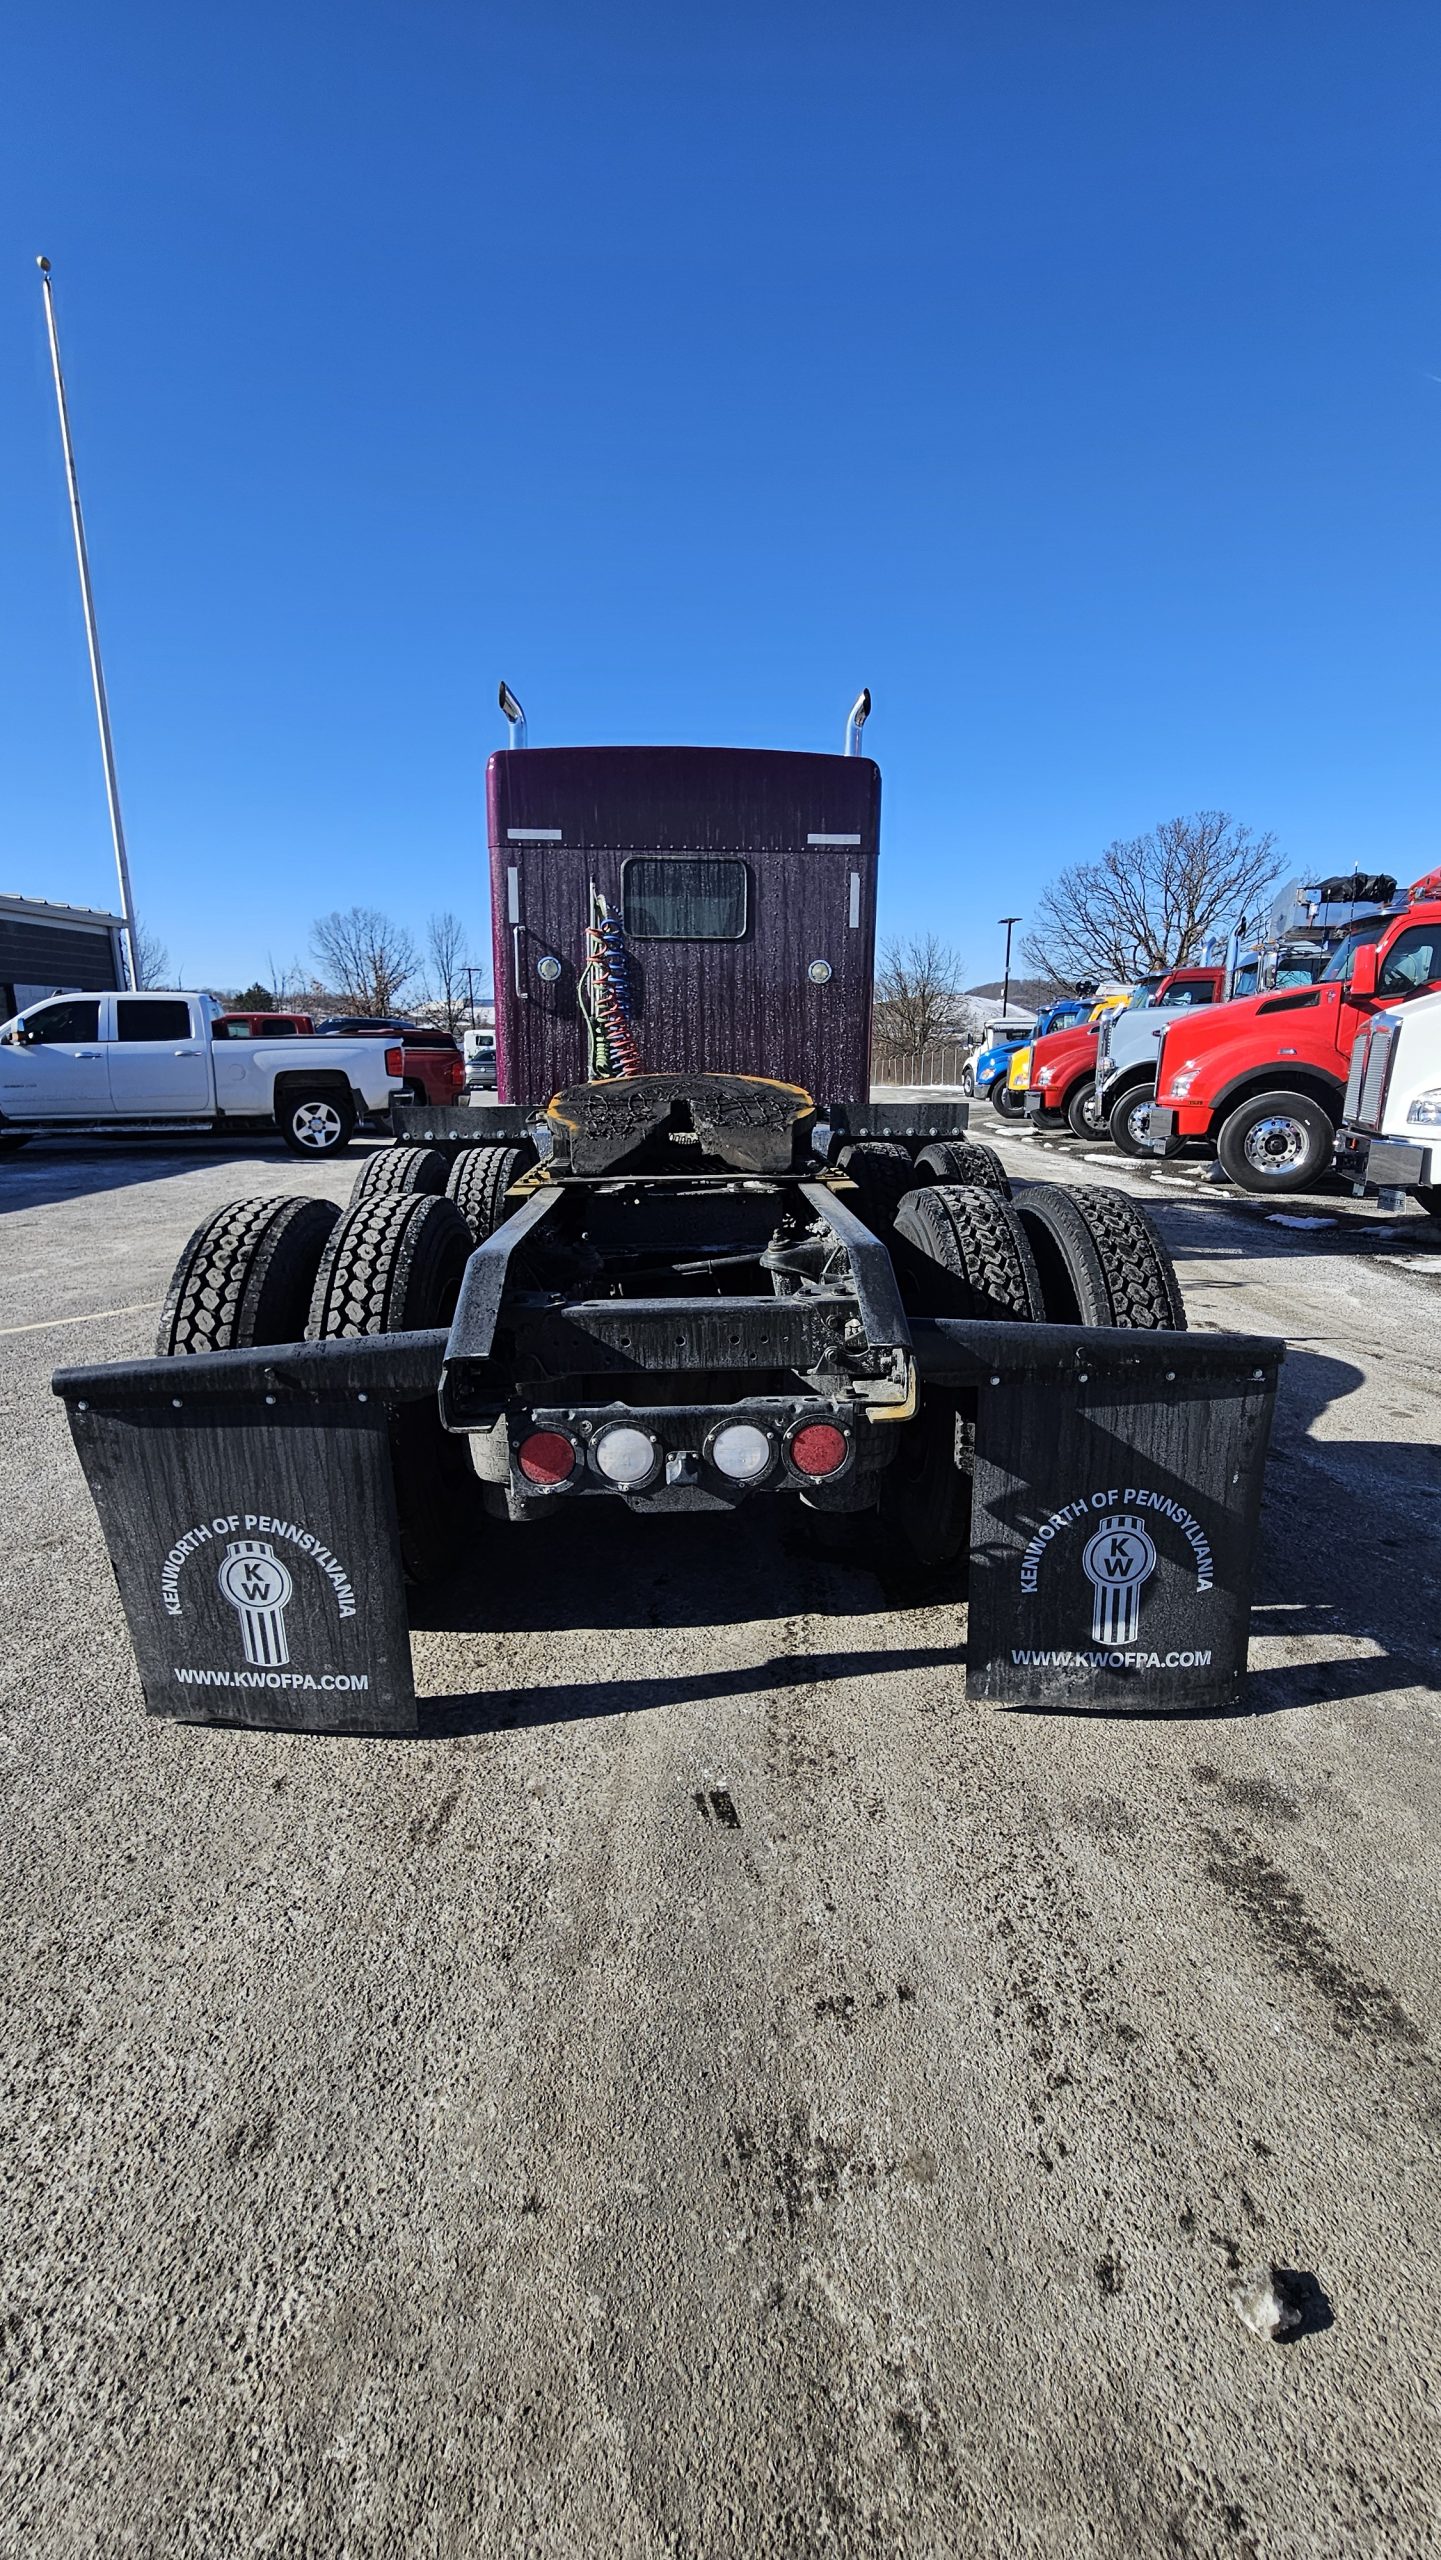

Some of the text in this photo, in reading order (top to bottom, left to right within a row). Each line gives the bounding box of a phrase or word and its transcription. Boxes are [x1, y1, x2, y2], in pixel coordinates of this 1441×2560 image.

[1021, 1489, 1213, 1593] KENWORTH OF PENNSYLVANIA
[1111, 1538, 1129, 1557] K
[162, 1516, 356, 1618] KENWORTH OF PENNSYLVANIA
[245, 1564, 265, 1581] K
[1104, 1558, 1133, 1577] W
[242, 1583, 270, 1601] W
[1012, 1650, 1212, 1668] WWW.KWOFPA.COM
[174, 1668, 368, 1690] WWW.KWOFPA.COM
